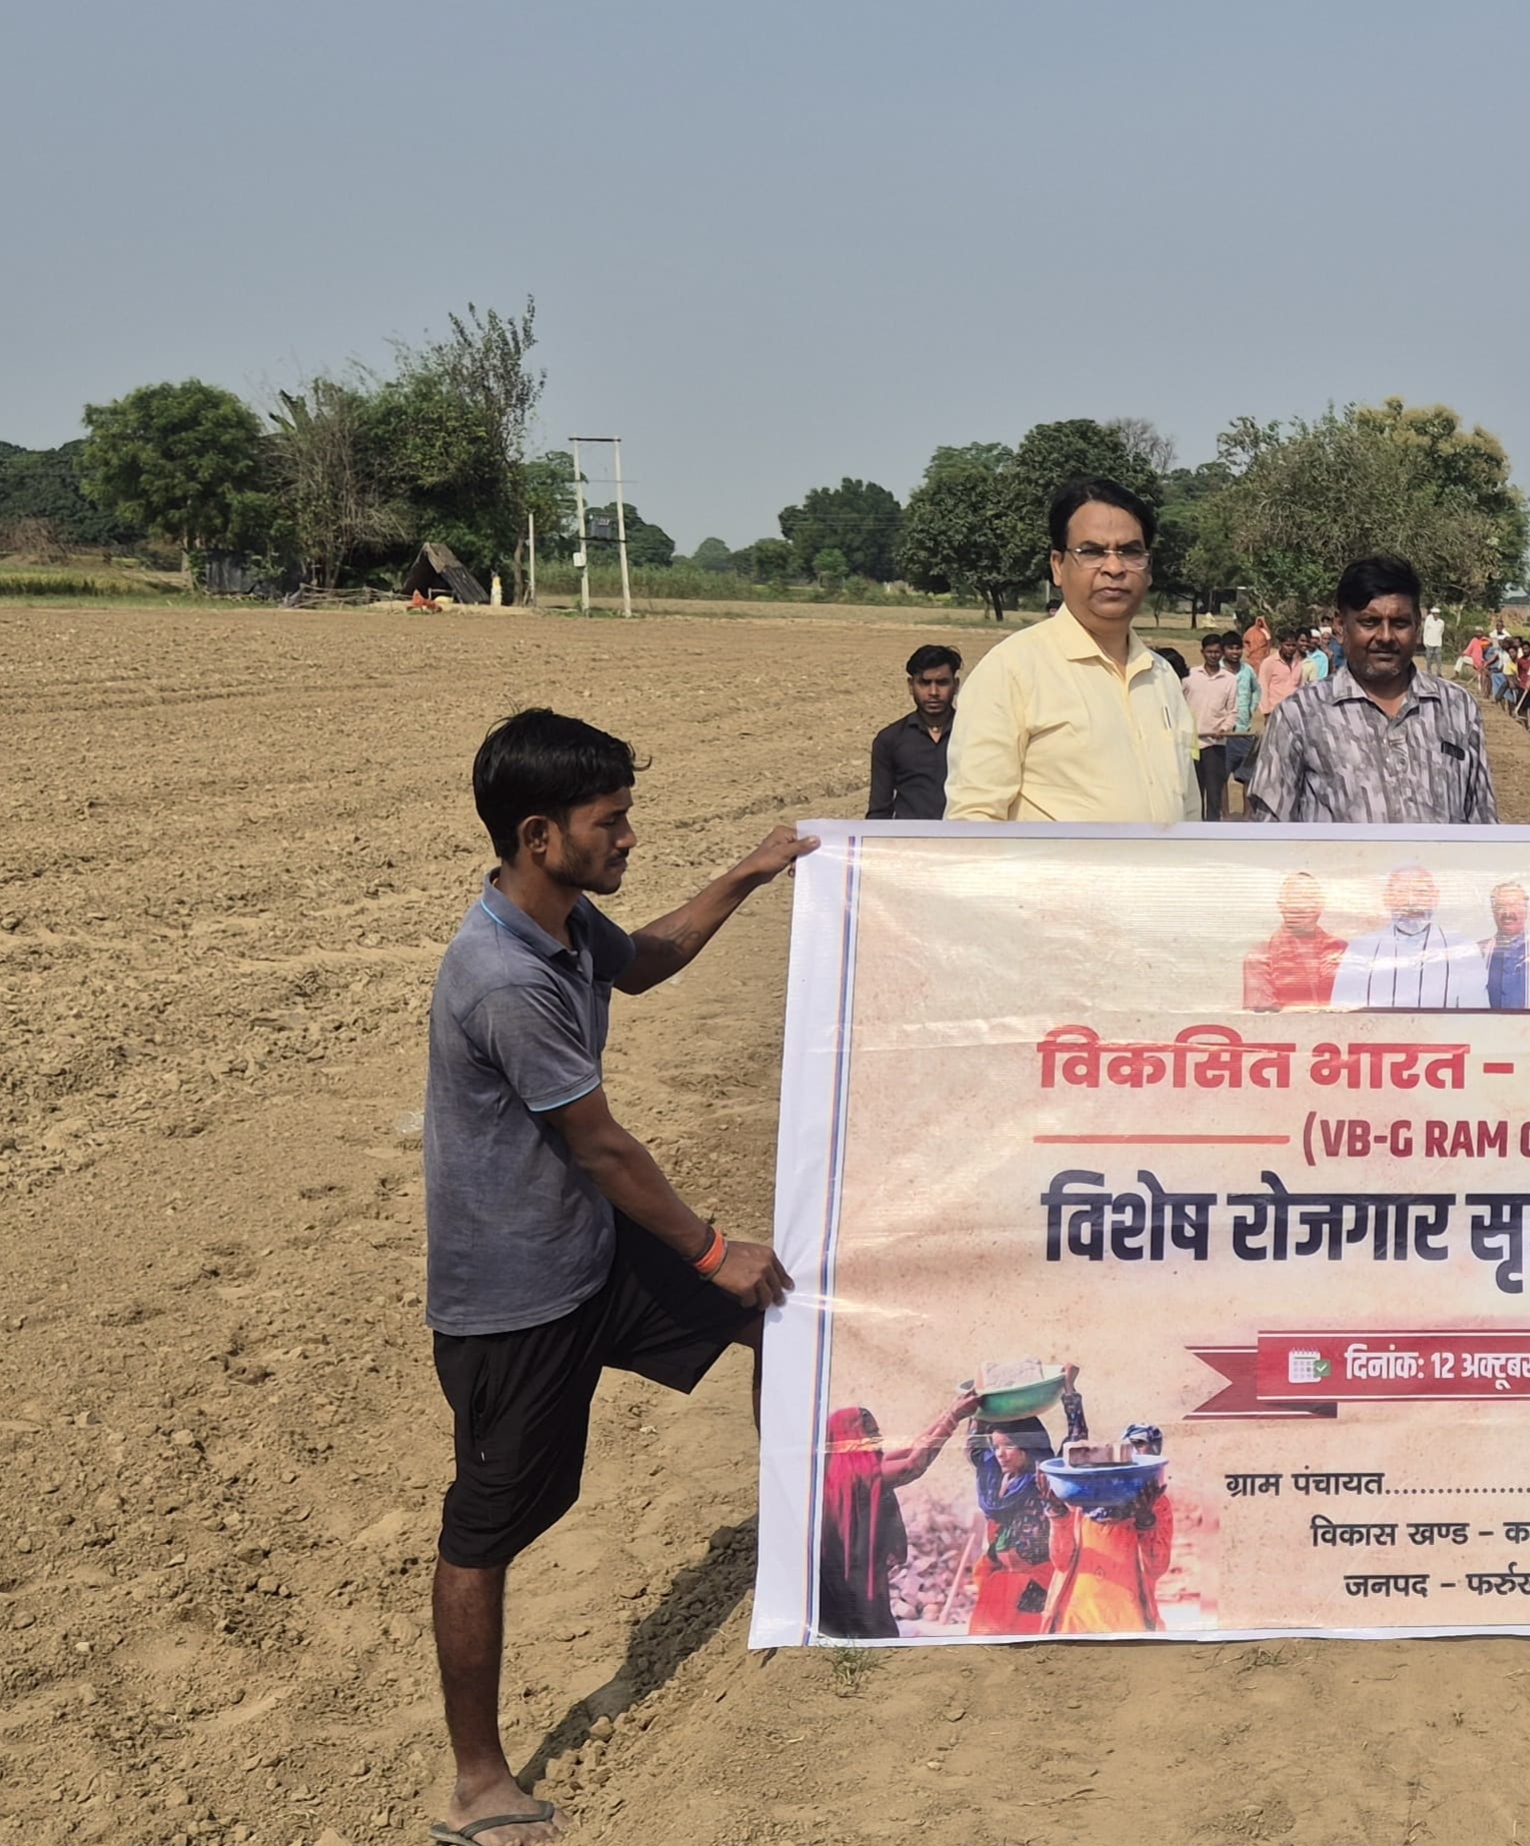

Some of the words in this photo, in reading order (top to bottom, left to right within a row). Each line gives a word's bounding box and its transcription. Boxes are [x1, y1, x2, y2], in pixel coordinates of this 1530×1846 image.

[1037, 1024, 1296, 1088] विकसित
[1310, 1043, 1470, 1089] भारत
[1303, 1111, 1413, 1166] (VB-G
[1425, 1120, 1508, 1158] RAM
[1041, 1170, 1217, 1261] विशेष
[1227, 1171, 1456, 1261] रोजगार
[1344, 1343, 1424, 1379] दिनांक:
[1431, 1352, 1454, 1378] 12
[1225, 1474, 1283, 1497] ग्राम
[1310, 1514, 1398, 1547] विकास
[1406, 1523, 1470, 1545] खण्ड
[1344, 1574, 1430, 1597] जनपद
